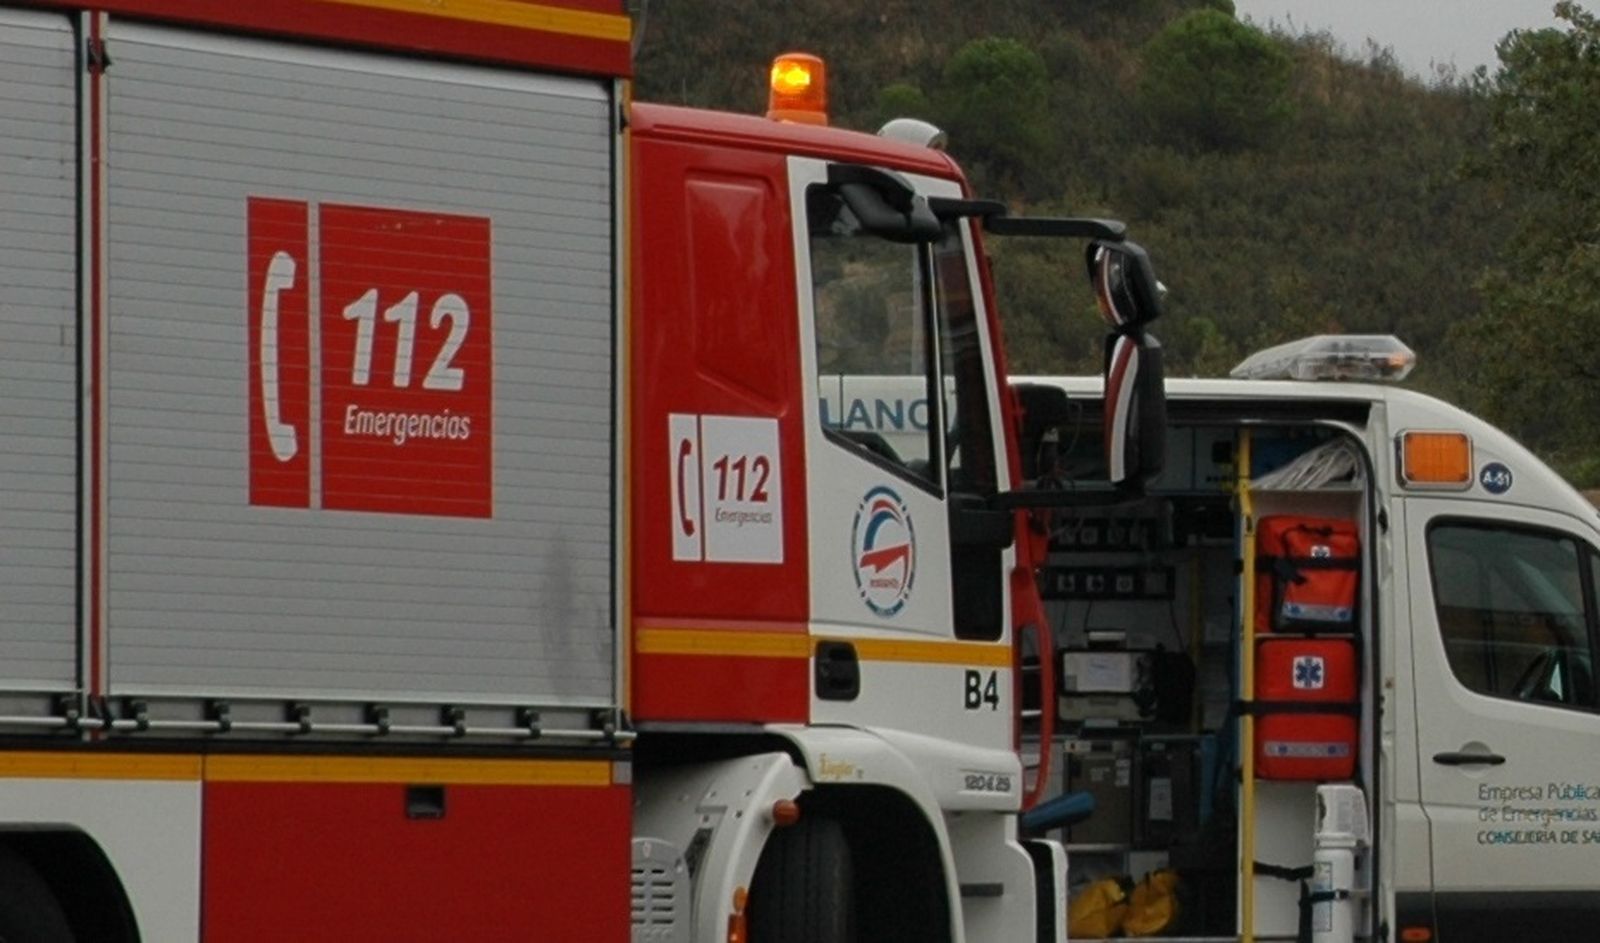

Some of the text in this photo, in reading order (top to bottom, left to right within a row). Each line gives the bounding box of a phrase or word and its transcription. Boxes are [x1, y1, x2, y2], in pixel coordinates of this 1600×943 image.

[343, 288, 470, 391] 112
[344, 404, 471, 446] Emergencias
[713, 455, 770, 502] 112
[965, 669, 999, 711] B4
[1478, 783, 1542, 804] Empresa
[1479, 805, 1598, 829] de Emergencias
[1560, 830, 1579, 844] DE
